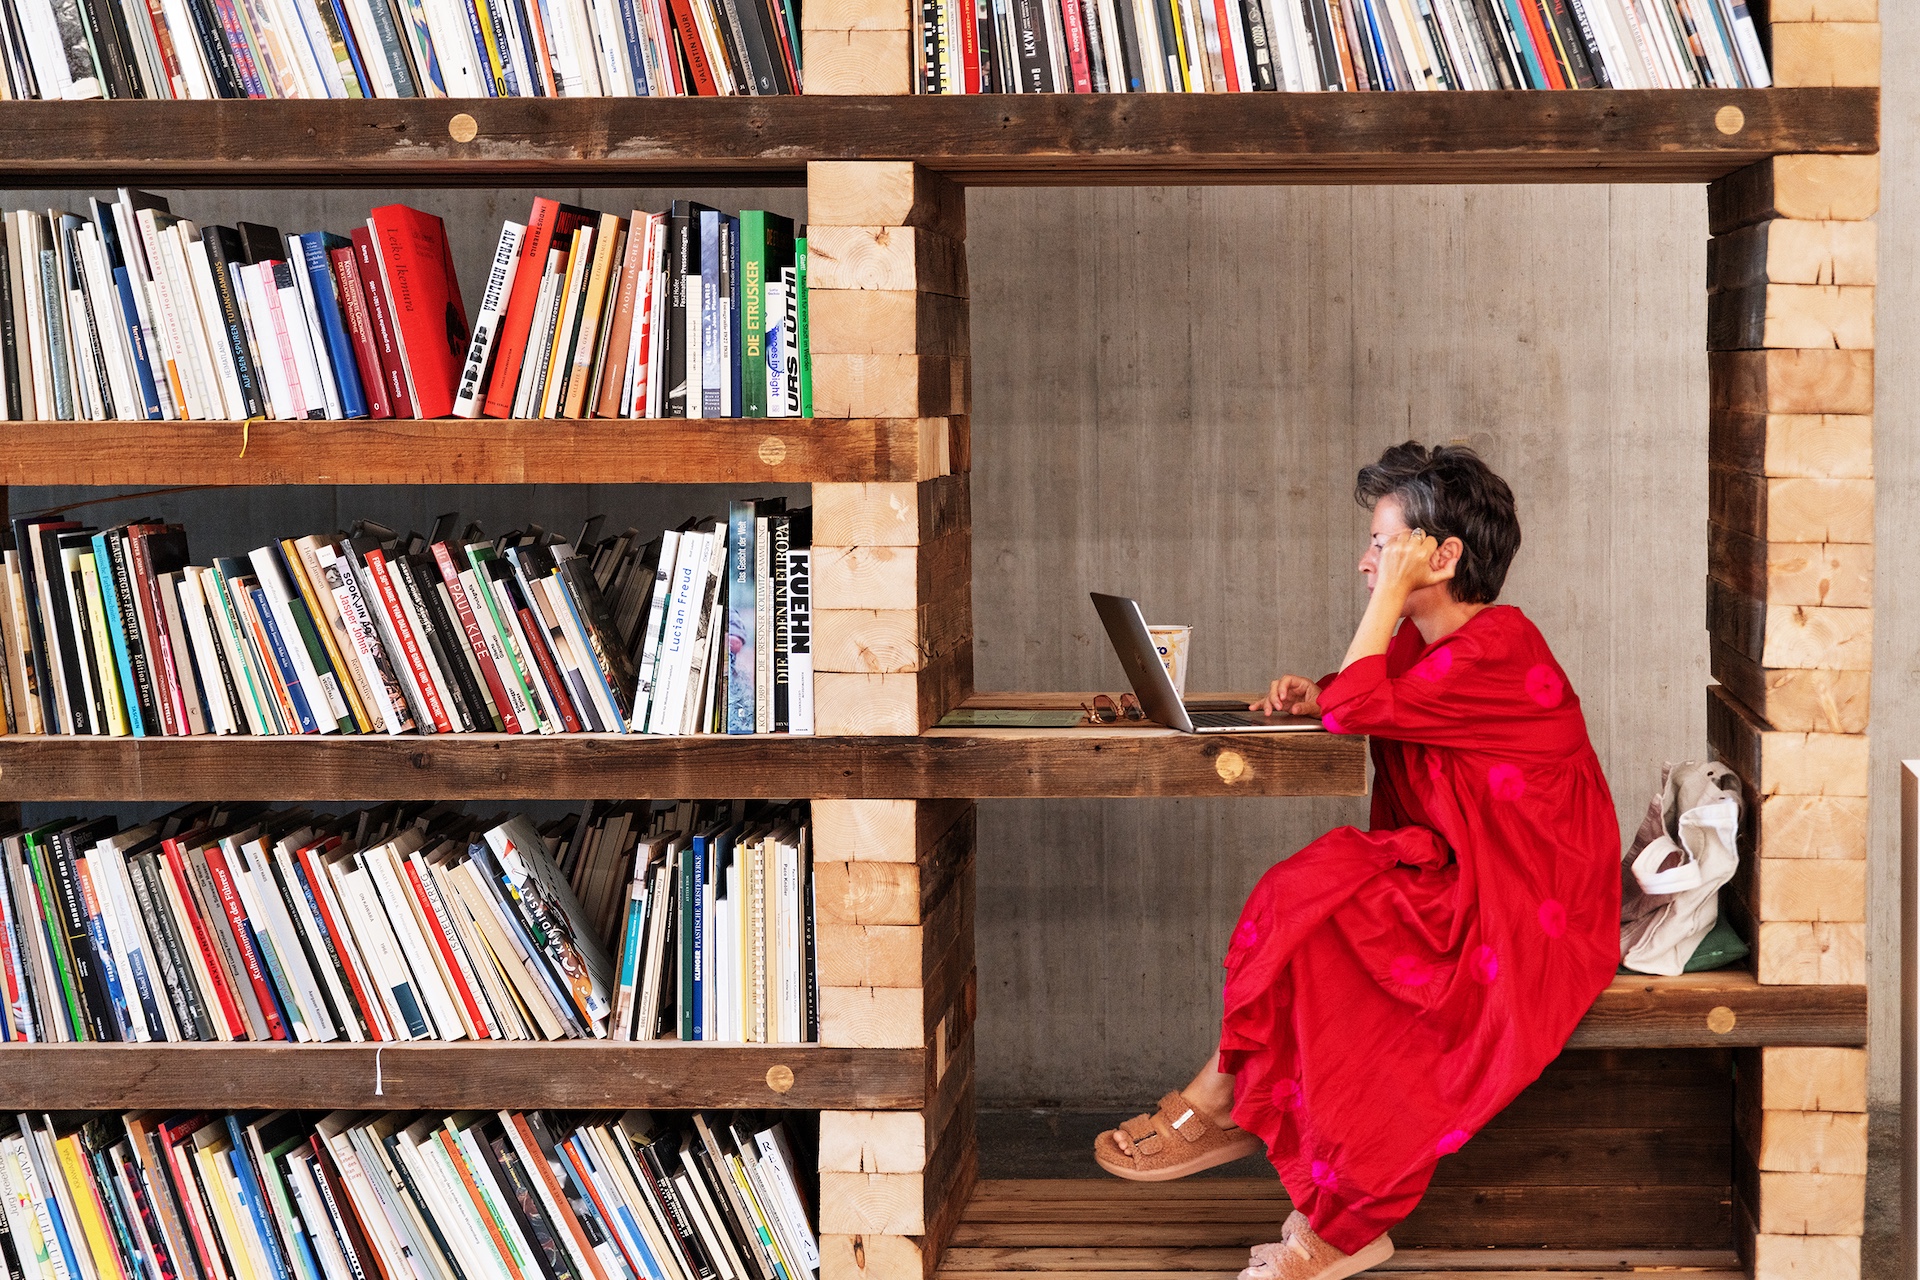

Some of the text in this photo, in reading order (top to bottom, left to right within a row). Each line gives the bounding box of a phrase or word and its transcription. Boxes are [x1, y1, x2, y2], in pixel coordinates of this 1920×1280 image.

[221, 10, 254, 93] GALERIE CHRISTIAN ZWANG
[230, 10, 263, 93] GALERIE CHRISTIAN ZWANG
[380, 16, 393, 42] Museum
[681, 13, 707, 83] VALENTIN HAURI
[1022, 29, 1035, 56] LKW
[1571, 0, 1598, 53] 31 KRATZU
[390, 51, 401, 70] Hesse
[396, 71, 406, 83] Eva
[143, 218, 162, 275] Landschaften
[529, 205, 546, 257] INDUSTRIEBILD
[386, 227, 415, 312] Leiko Ikemura
[483, 229, 515, 312] ALFRED HRDLICKA
[622, 226, 642, 313] PAOLO IACCHETTI
[166, 312, 182, 354] Ferdinand
[209, 235, 251, 388] AUF DEN SPUREN TUTANCHAMUNS HAWASS
[747, 260, 759, 356] DIE ETRUSKER
[782, 270, 798, 411] URS LÜTHI
[109, 534, 122, 563] KLAUS
[737, 521, 746, 582] Das Gesicht der Welt
[774, 523, 789, 580] EUROPA
[337, 592, 370, 654] Jasper Johns
[449, 582, 488, 659] PAUL KLEE
[668, 567, 692, 652] Lucian Freud
[790, 555, 809, 653] KUEHN
[134, 653, 151, 707] Edition Braus
[349, 657, 372, 701] Retrospektive
[776, 658, 787, 684] DIE
[131, 705, 139, 728] TASCHEN
[51, 834, 81, 928] REGEL UND ABWEICHUNG
[132, 868, 152, 911] YVES KLEIN
[200, 862, 209, 879] Museen
[207, 880, 218, 903] Schweizer
[227, 901, 239, 916] des
[419, 872, 460, 952] ISABELLE KRIEG
[520, 885, 565, 954] KANDINSKY
[196, 925, 222, 986] MAXIM KANTOR
[218, 929, 239, 976] Ernst Ludwig Kirchner
[256, 928, 293, 1005] Raoul De Keyser
[138, 976, 150, 1000] Michael
[460, 964, 486, 1006] ALL TAG
[14, 1144, 33, 1180] SCAPA
[61, 1148, 81, 1189] KRAWAGNA
[322, 1184, 333, 1203] Macht
[270, 1245, 282, 1270] Architektur
